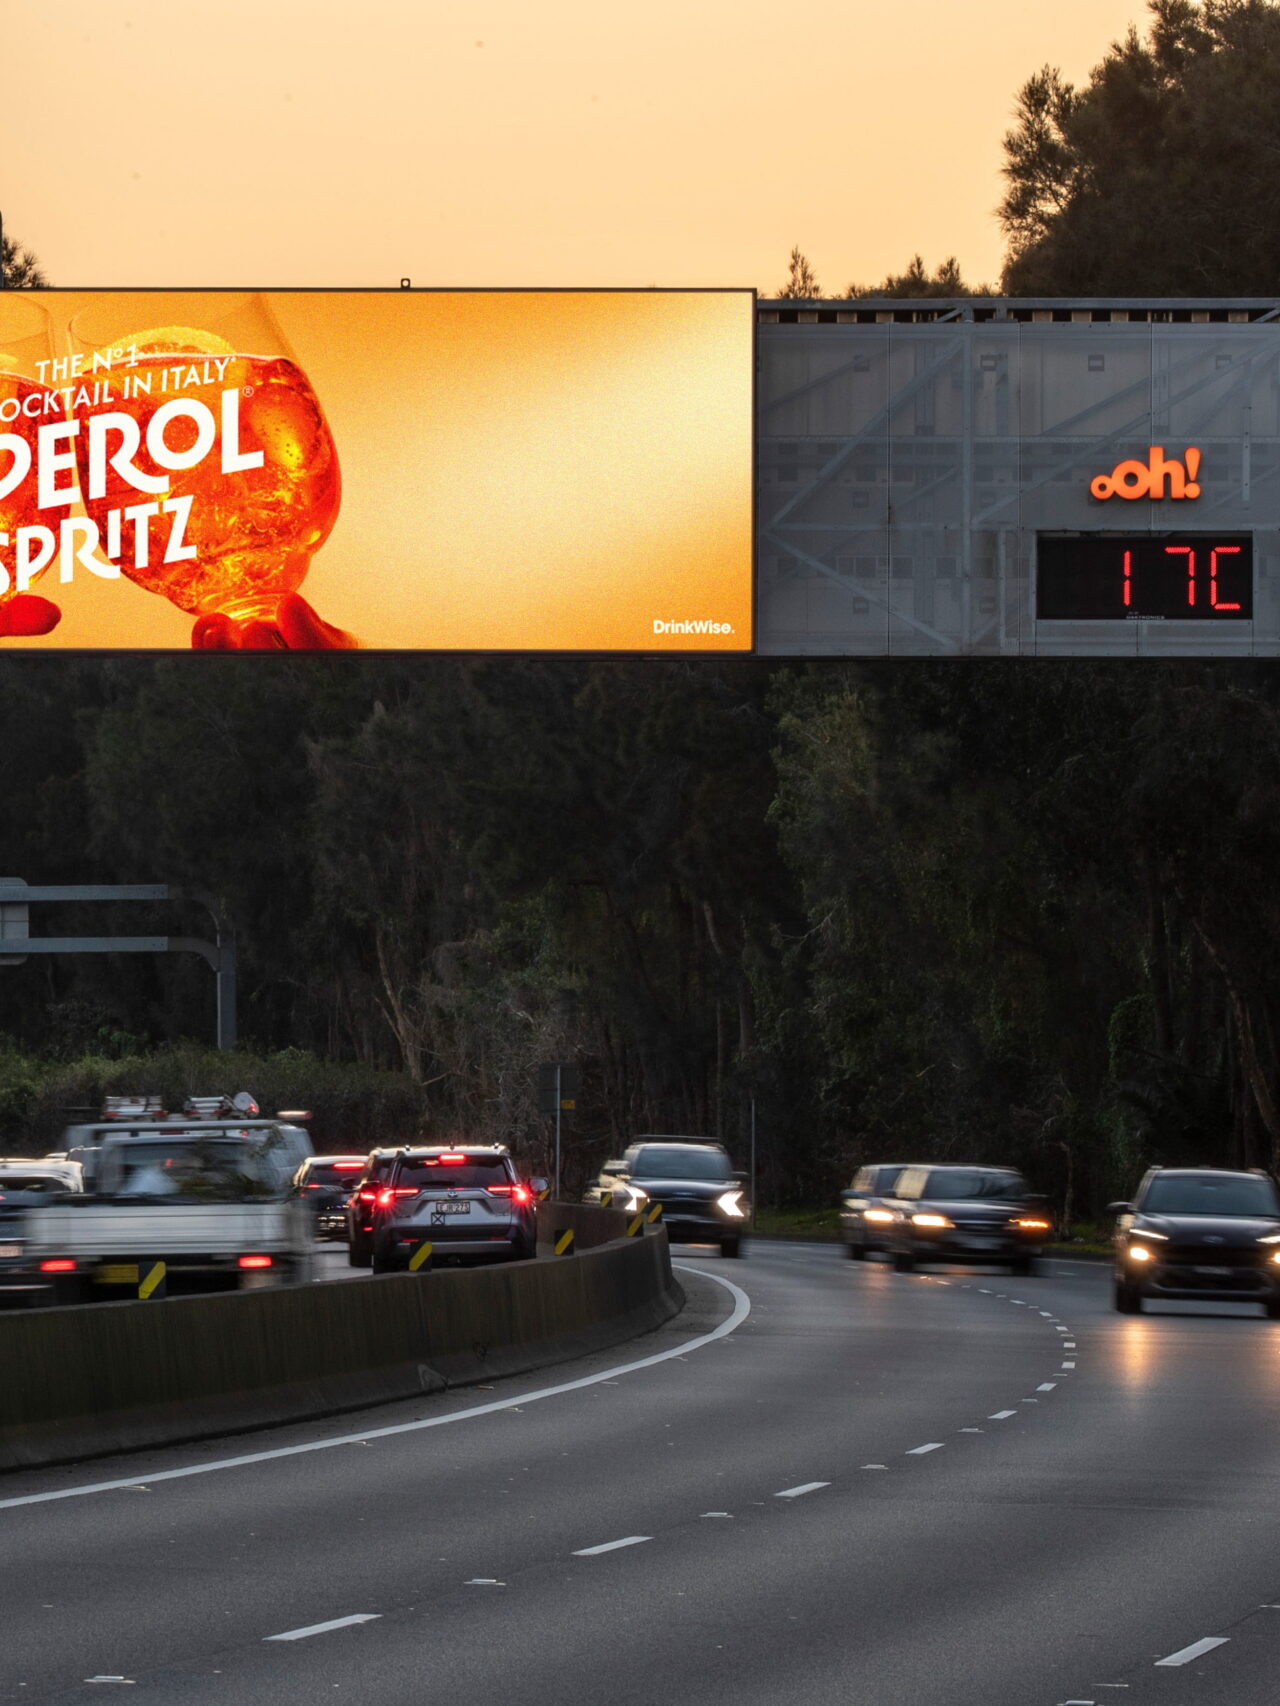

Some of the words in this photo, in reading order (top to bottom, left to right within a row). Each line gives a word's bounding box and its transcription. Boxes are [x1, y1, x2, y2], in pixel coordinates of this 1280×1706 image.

[35, 353, 84, 384] THE
[123, 372, 152, 400] IN
[653, 619, 736, 634] DrinkWise.
